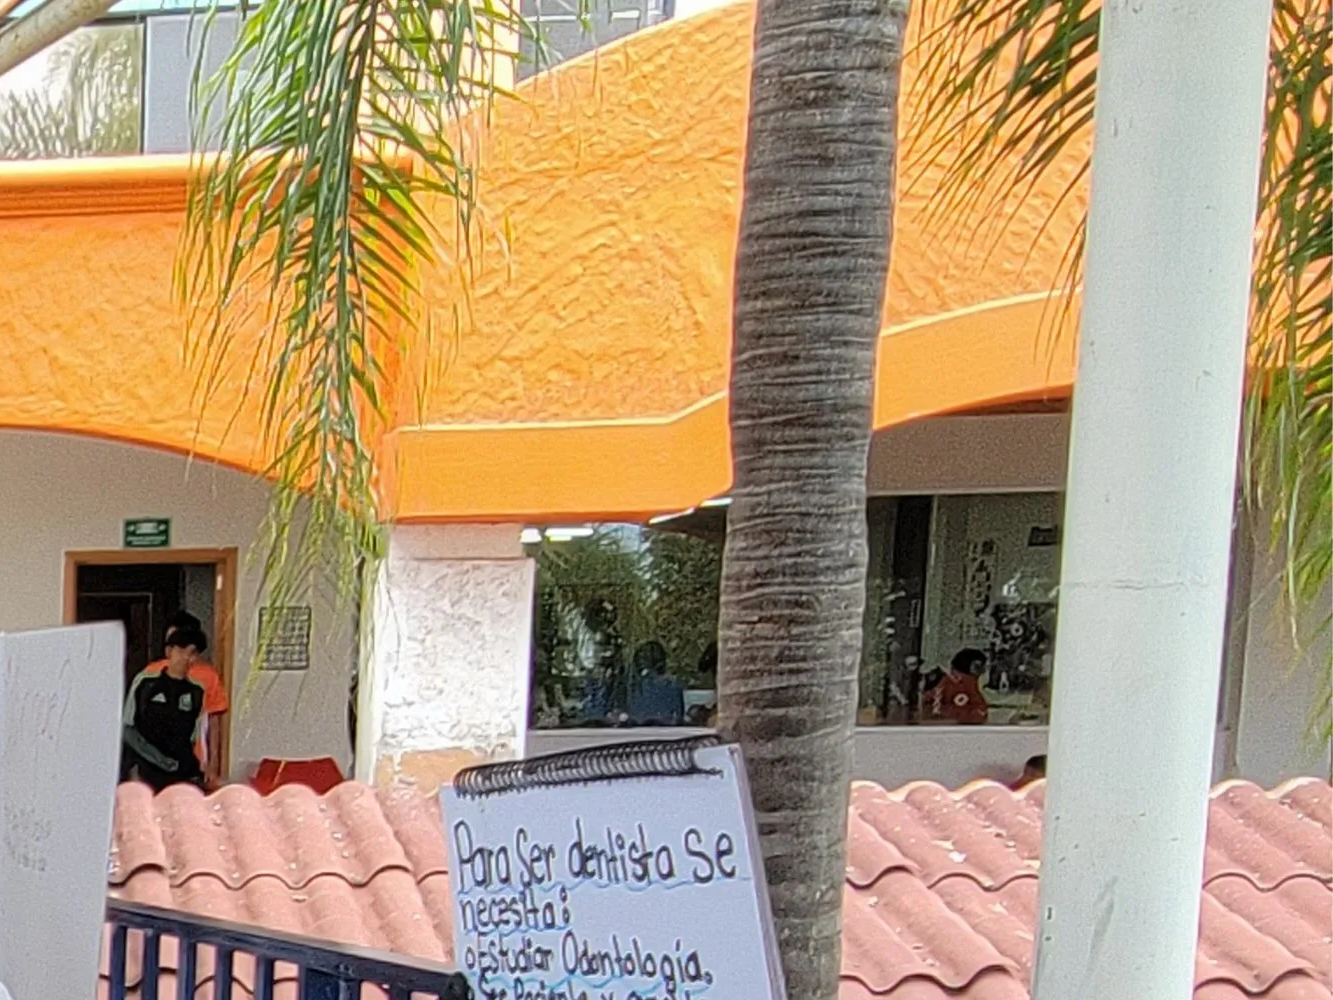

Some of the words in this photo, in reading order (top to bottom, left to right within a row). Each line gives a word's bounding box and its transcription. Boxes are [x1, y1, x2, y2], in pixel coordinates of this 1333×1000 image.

[454, 819, 511, 893] Para
[516, 827, 556, 888] Ser
[568, 817, 676, 882] dentista
[684, 827, 737, 884] Se
